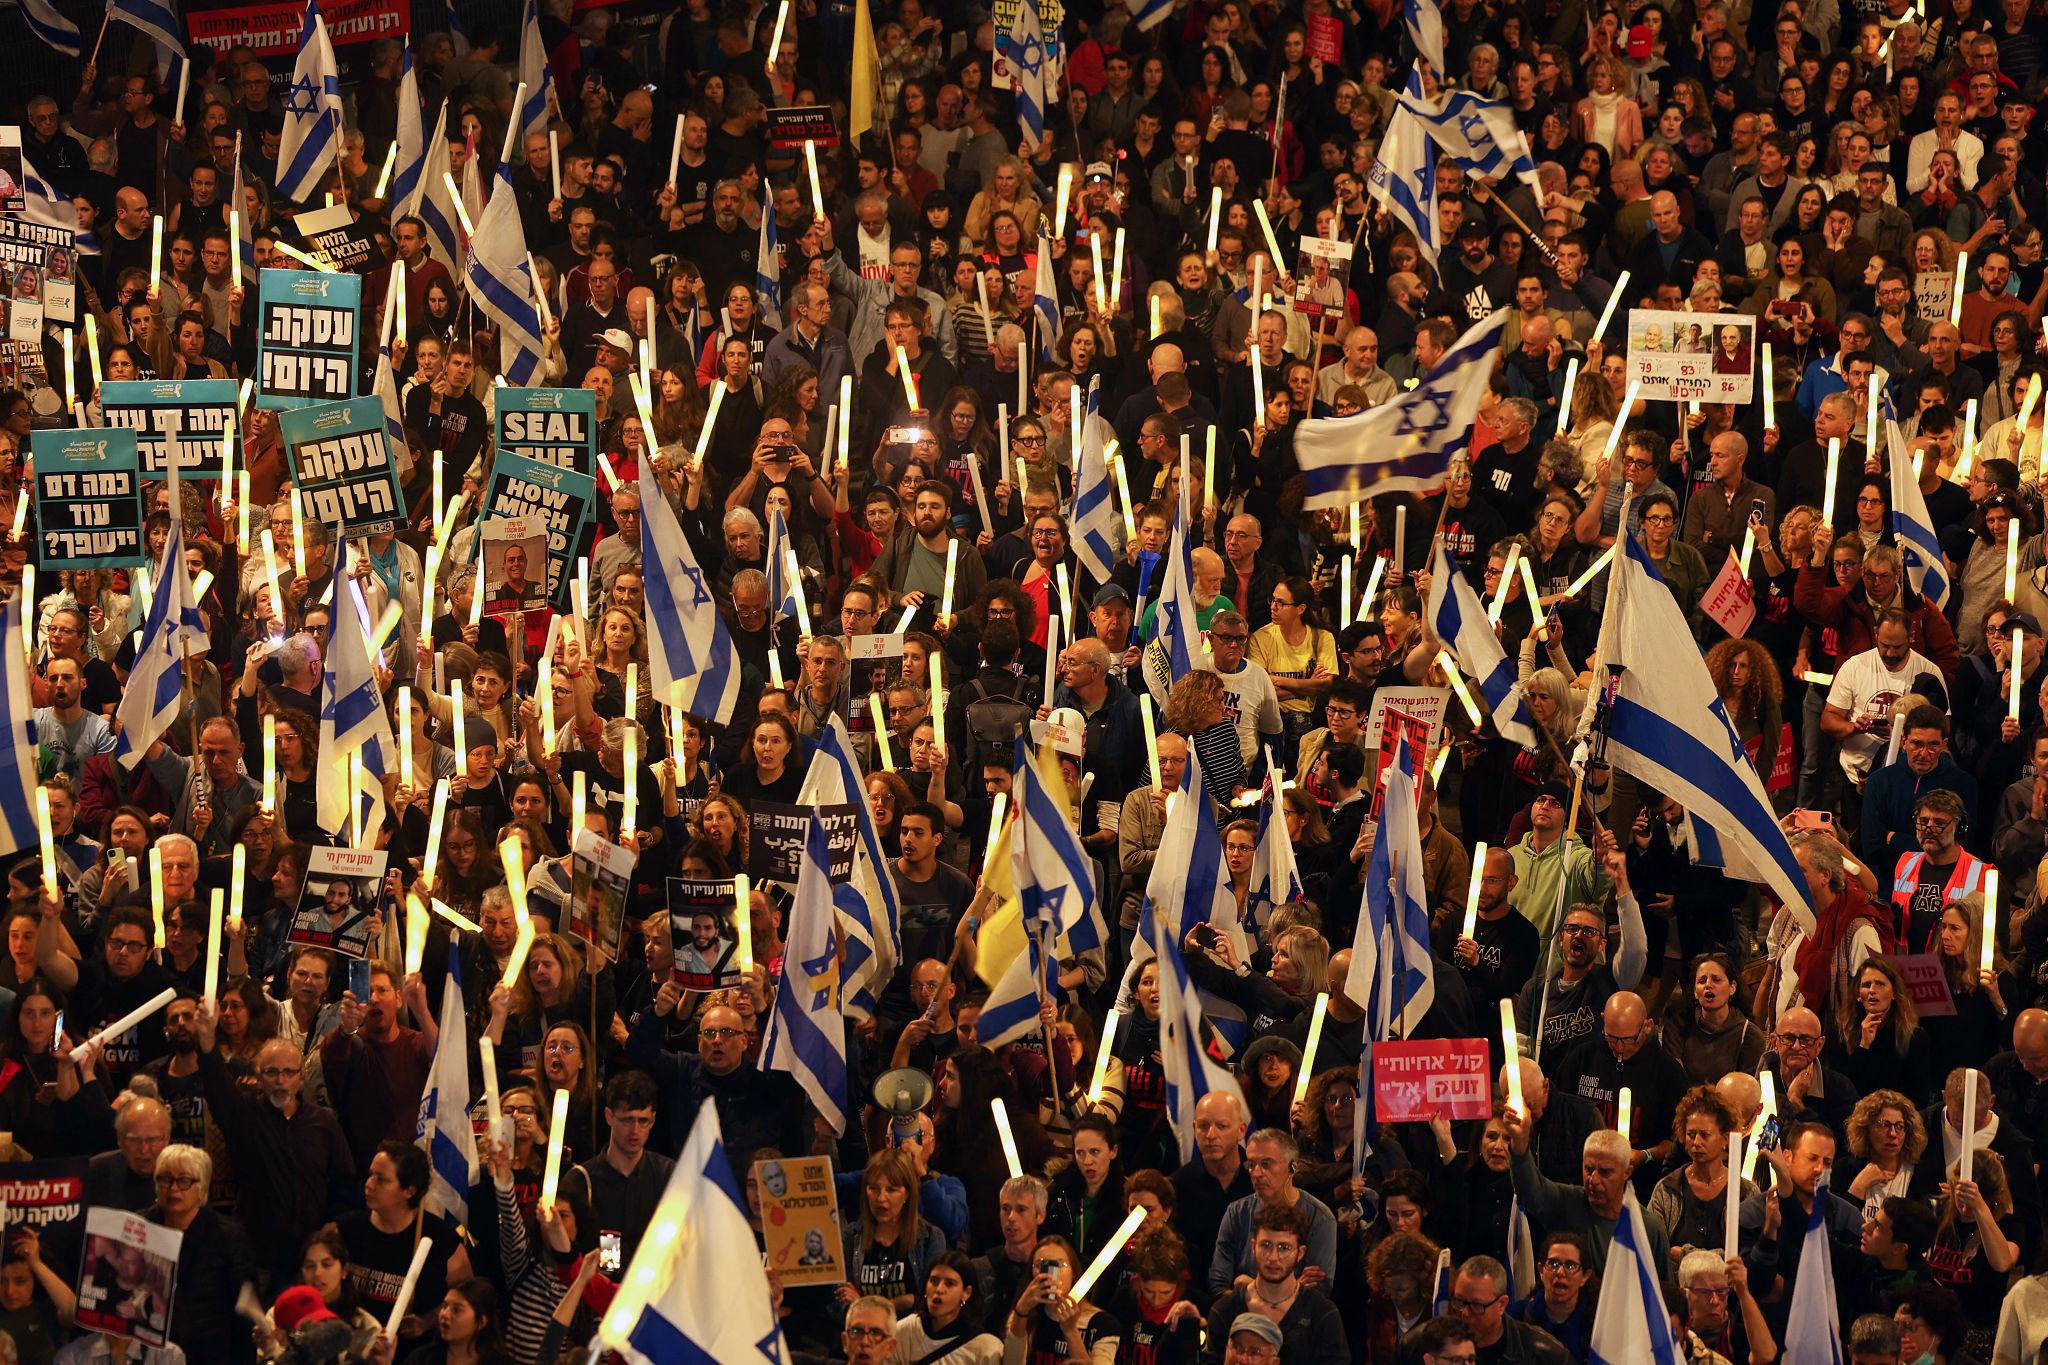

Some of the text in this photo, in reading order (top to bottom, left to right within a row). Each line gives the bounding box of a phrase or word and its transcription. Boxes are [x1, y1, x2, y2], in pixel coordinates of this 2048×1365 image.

[380, 12, 400, 32] רק
[19, 224, 71, 247] זועקות
[315, 230, 350, 250] הלחץ
[331, 238, 371, 258] הצבאי
[264, 307, 353, 347] עסקה.
[263, 352, 348, 394] היום!
[1639, 363, 1652, 373] 79
[1680, 366, 1695, 376] 83
[1642, 375, 1712, 388] החזירו אותם
[1721, 382, 1735, 392] 86
[106, 409, 146, 432] עוד
[189, 408, 236, 432] כמה
[505, 413, 585, 442] SEAL
[298, 431, 387, 480] עסקה.
[45, 473, 130, 497] כמה דם
[506, 477, 570, 511] HOW
[69, 503, 111, 526] עוד
[494, 494, 570, 532] MUCH
[45, 531, 137, 559] יישפך?
[1721, 600, 1742, 625] אליי
[1383, 696, 1440, 706] כל רגע שמאחר
[774, 814, 841, 831] למחמה
[843, 815, 857, 828] די
[764, 828, 857, 852] أوقف حرب
[327, 852, 373, 866] מתן עדיין חי
[681, 883, 734, 897] מתן עדיין חי
[294, 920, 310, 931] HIM
[297, 911, 320, 923] BRING
[674, 949, 693, 962] BRING
[1914, 984, 1940, 998] זוע
[1378, 1053, 1484, 1072] קול אחיותיי
[1379, 1080, 1480, 1099] זועק אליי
[1579, 1074, 1600, 1088] BRING
[1578, 1085, 1614, 1102] THEM HOME
[0, 1179, 71, 1202] די למלח
[28, 1202, 81, 1226] עסקה
[384, 1271, 406, 1286] MISSI
[374, 1281, 403, 1298] FORU
